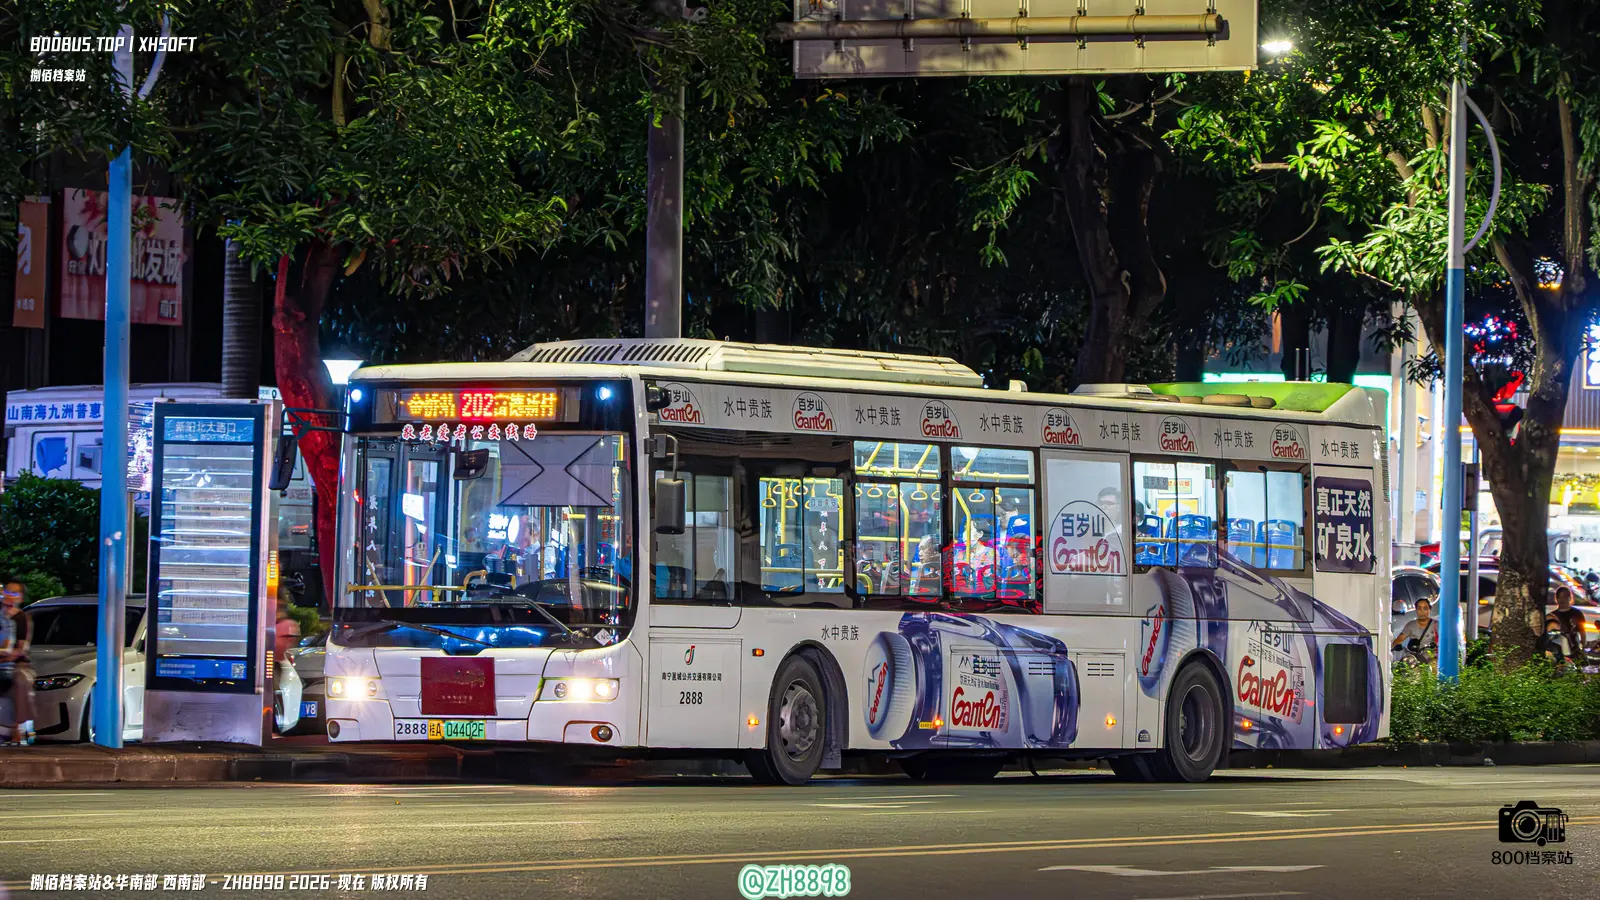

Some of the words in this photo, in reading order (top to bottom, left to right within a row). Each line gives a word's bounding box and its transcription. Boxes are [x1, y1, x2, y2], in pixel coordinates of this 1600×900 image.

[461, 393, 493, 417] 202
[724, 397, 772, 419] 水中贵族
[798, 398, 824, 412] 百岁山
[926, 406, 949, 419] 百岁山
[794, 410, 833, 431] Ganten
[855, 405, 901, 426] 水中贵族
[980, 413, 1024, 434] 水中贵族
[1047, 414, 1070, 427] 百岁山
[402, 423, 537, 441] 敬老爱老公交线路
[922, 418, 959, 438] Ganten
[1044, 425, 1079, 445] Ganten
[1099, 420, 1140, 441] 水中贵族
[1164, 421, 1186, 434] 百岁山
[1276, 429, 1296, 441] 百岁山
[1161, 433, 1195, 453] Ganten
[1214, 429, 1254, 448] 水中贵族
[1272, 440, 1305, 459] Ganten
[1321, 439, 1360, 459] 水中贵族
[1316, 487, 1372, 518] 真正天然
[1061, 513, 1105, 538] 百岁山
[1317, 522, 1372, 562] 矿泉水
[1053, 536, 1120, 573] Ganten
[821, 624, 859, 640] 水中贵族
[1238, 655, 1295, 717] Ganten
[679, 691, 703, 705] 2888
[952, 686, 1001, 729] Ganten
[397, 723, 427, 735] 2888
